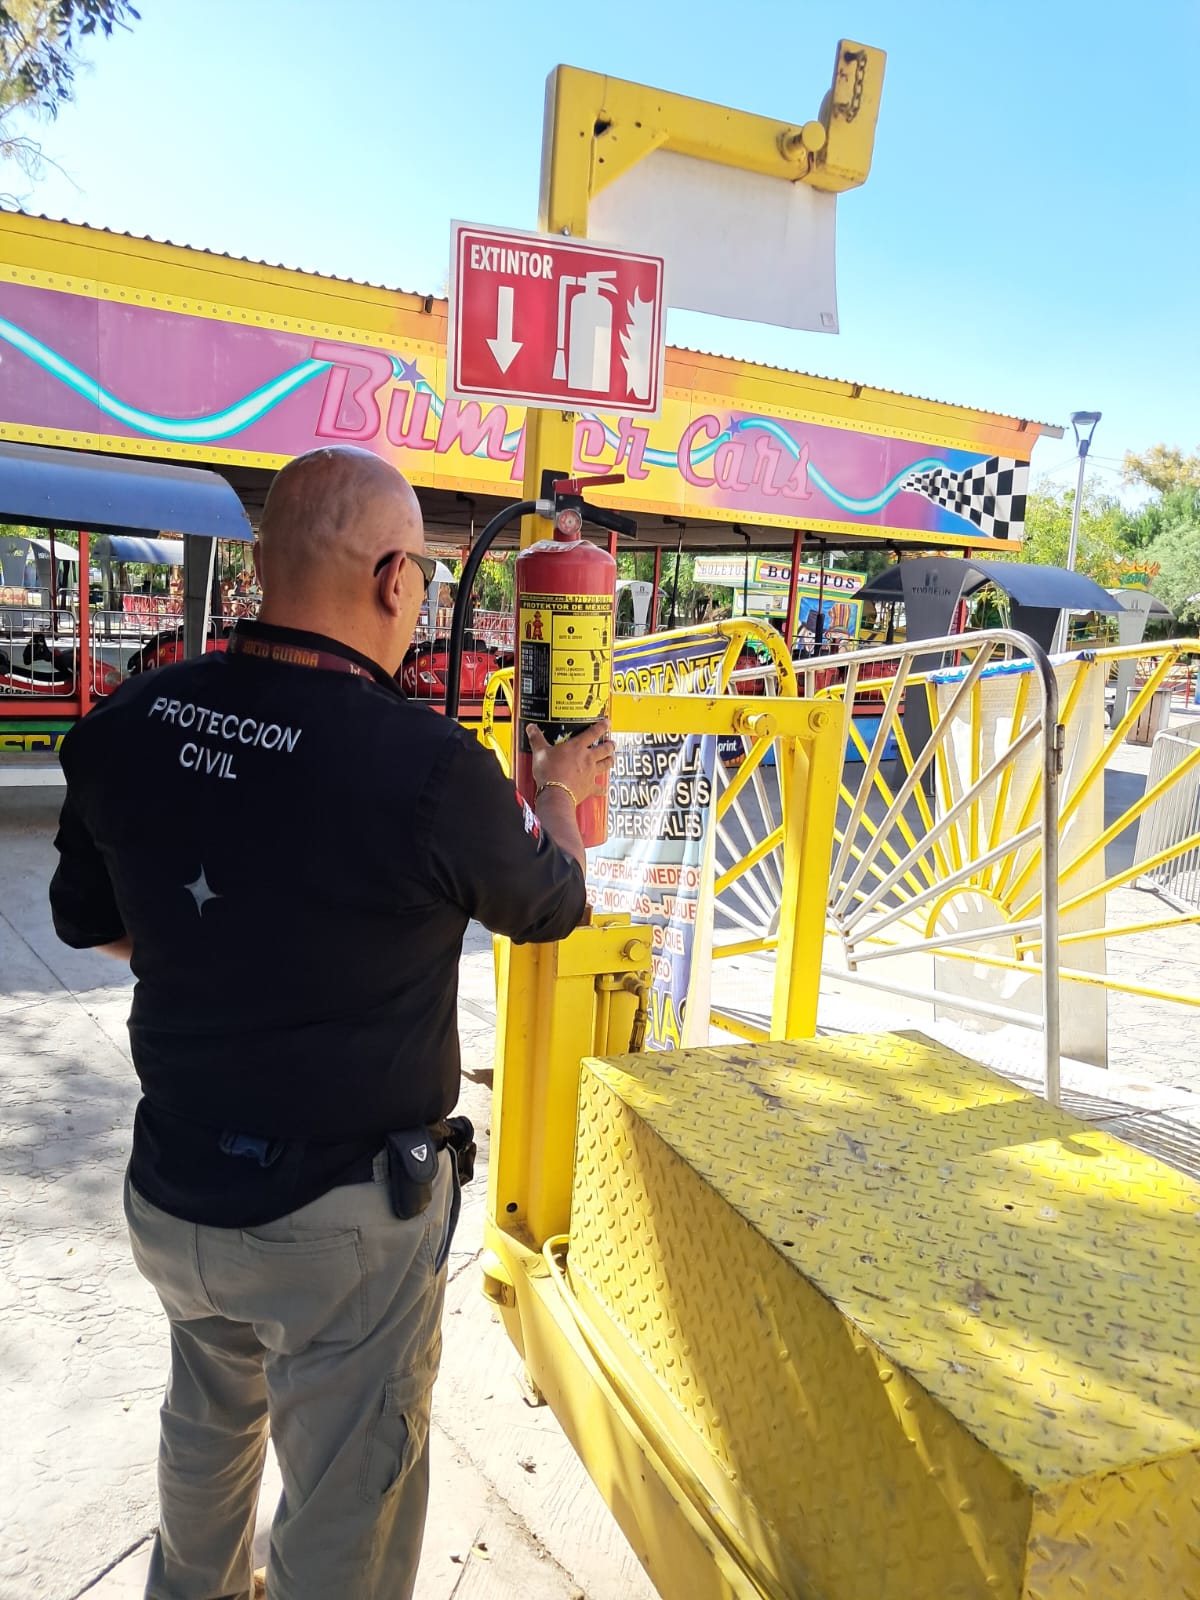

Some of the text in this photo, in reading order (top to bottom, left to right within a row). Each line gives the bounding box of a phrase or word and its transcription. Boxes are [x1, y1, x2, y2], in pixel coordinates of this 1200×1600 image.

[470, 243, 553, 280] EXTINTOR
[677, 414, 813, 500] Cars
[272, 644, 320, 668] GUINDA
[403, 666, 417, 689] 13
[148, 696, 302, 752] PROTECCION
[179, 742, 237, 779] CIVIL
